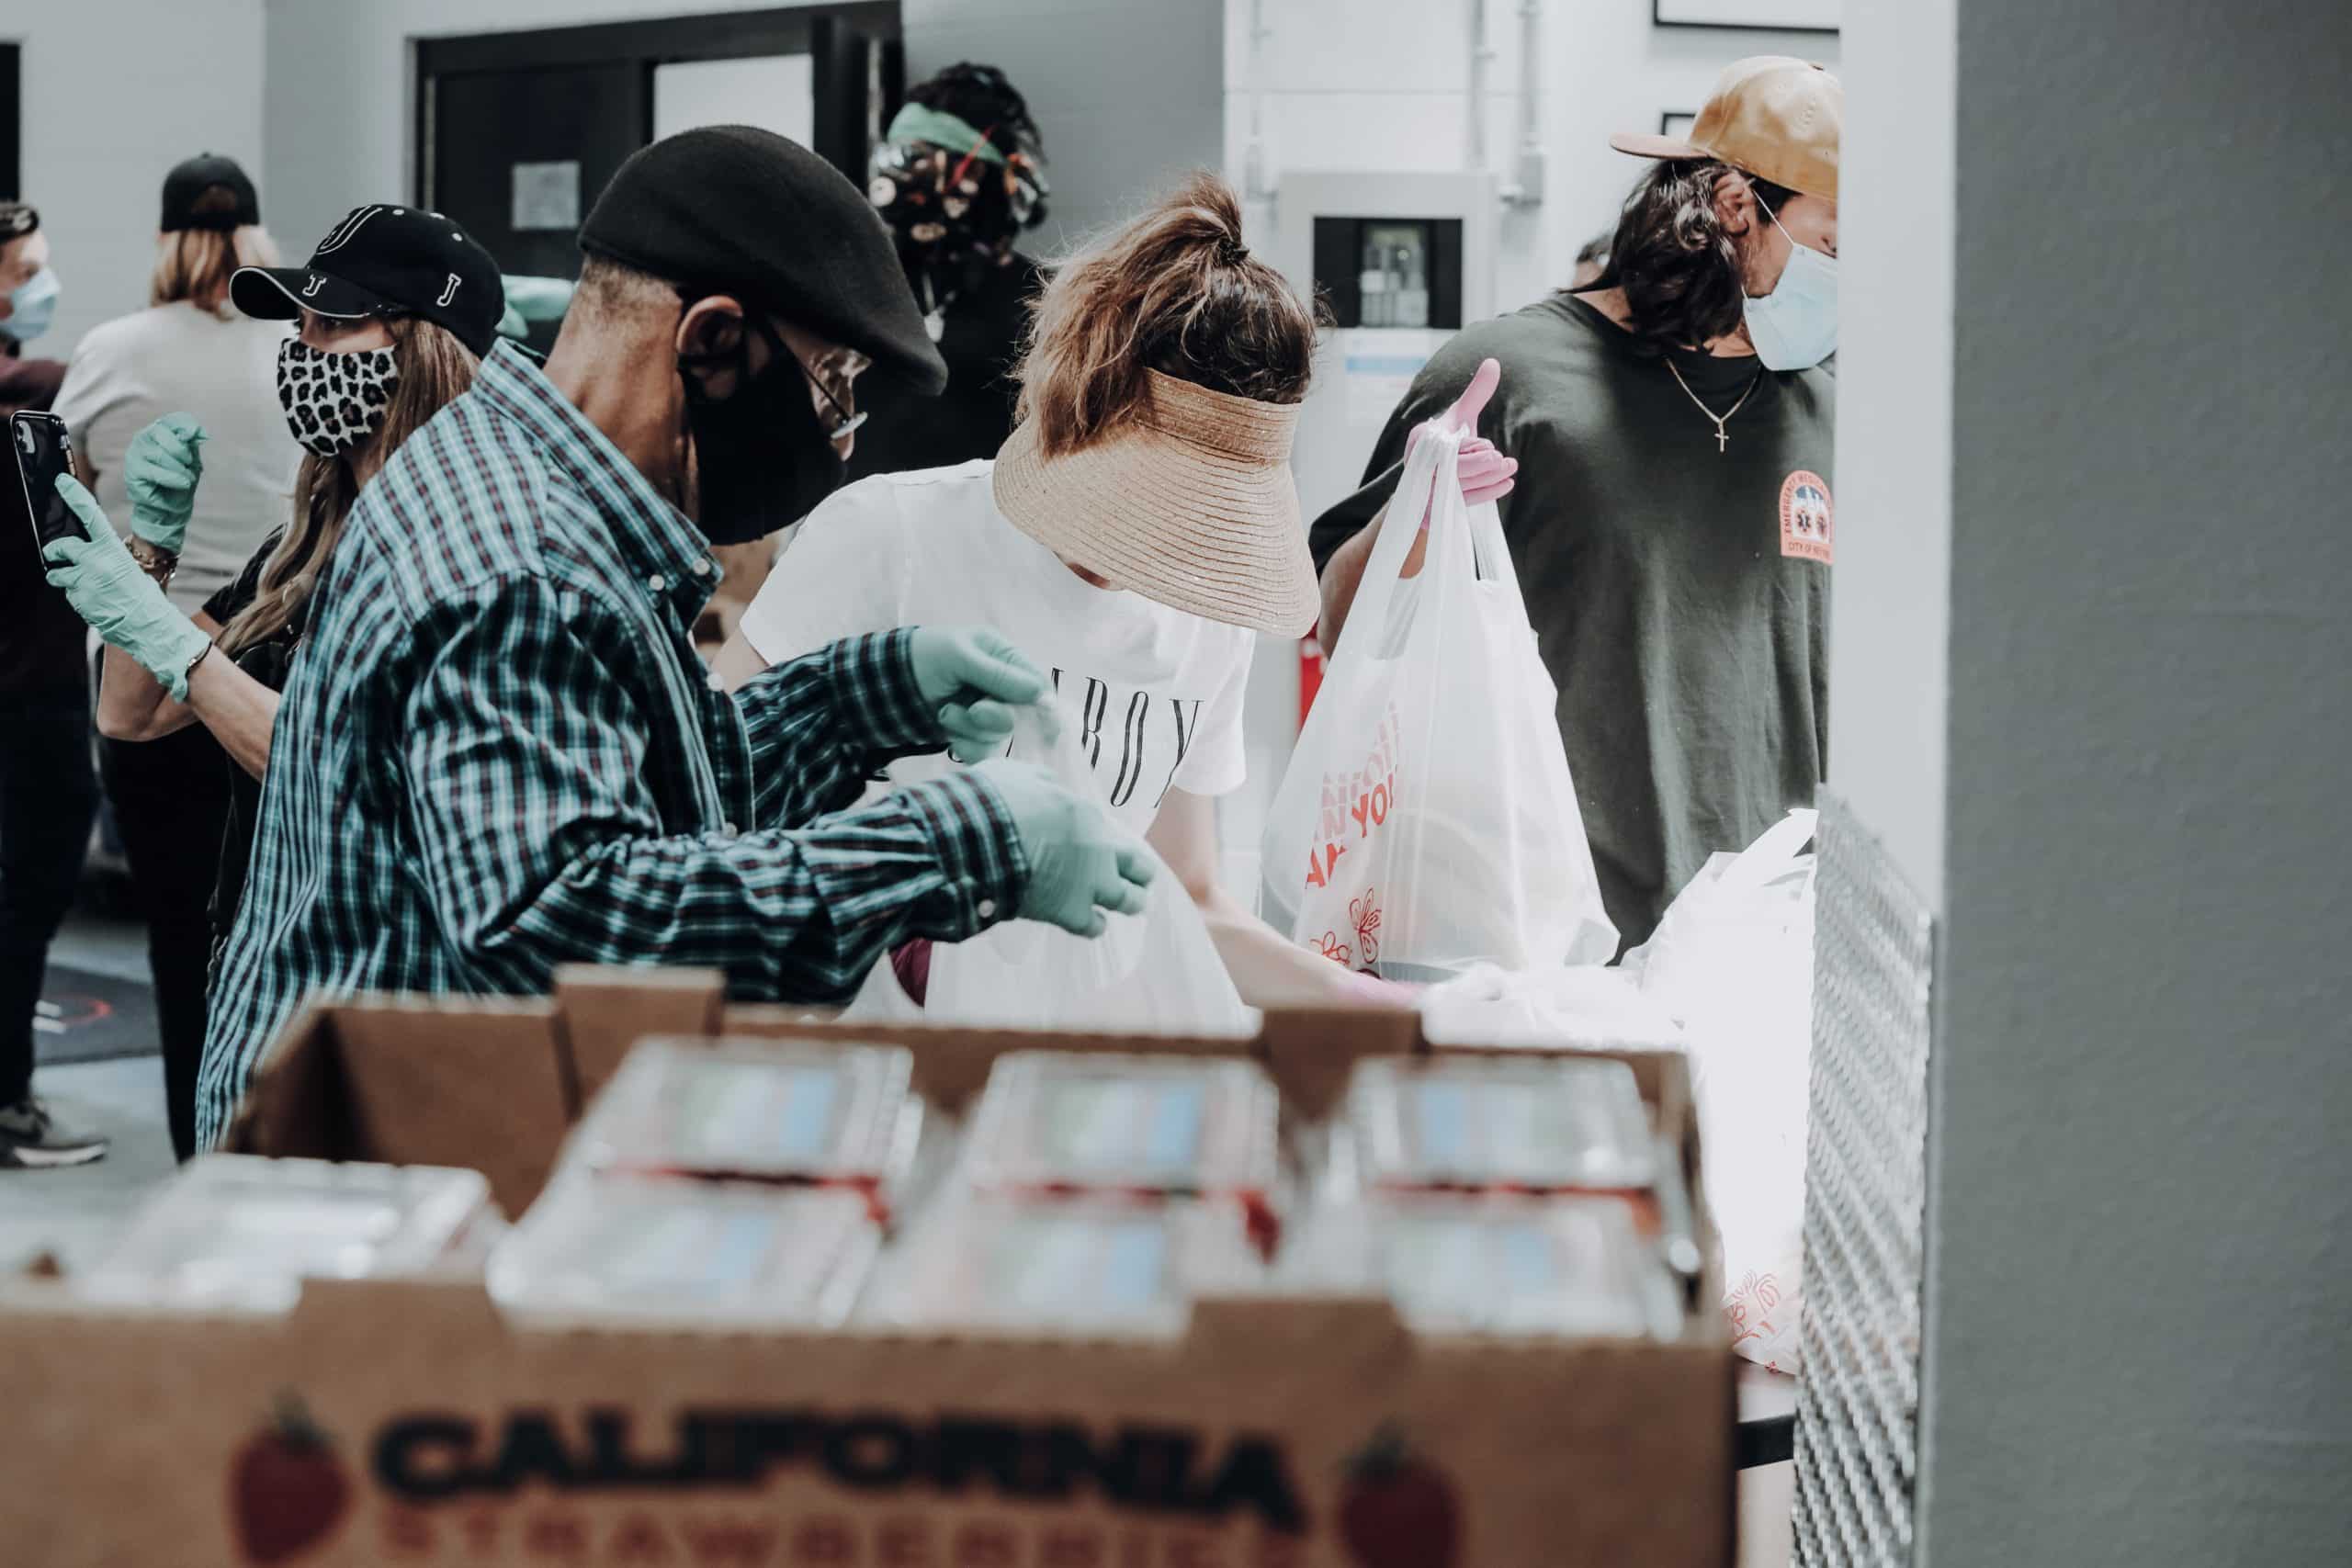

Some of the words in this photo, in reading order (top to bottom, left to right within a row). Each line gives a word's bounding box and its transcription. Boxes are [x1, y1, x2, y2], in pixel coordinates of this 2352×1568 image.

[302, 274, 326, 297] J
[436, 273, 461, 307] J
[375, 1405, 1308, 1531] CALIFORNIA
